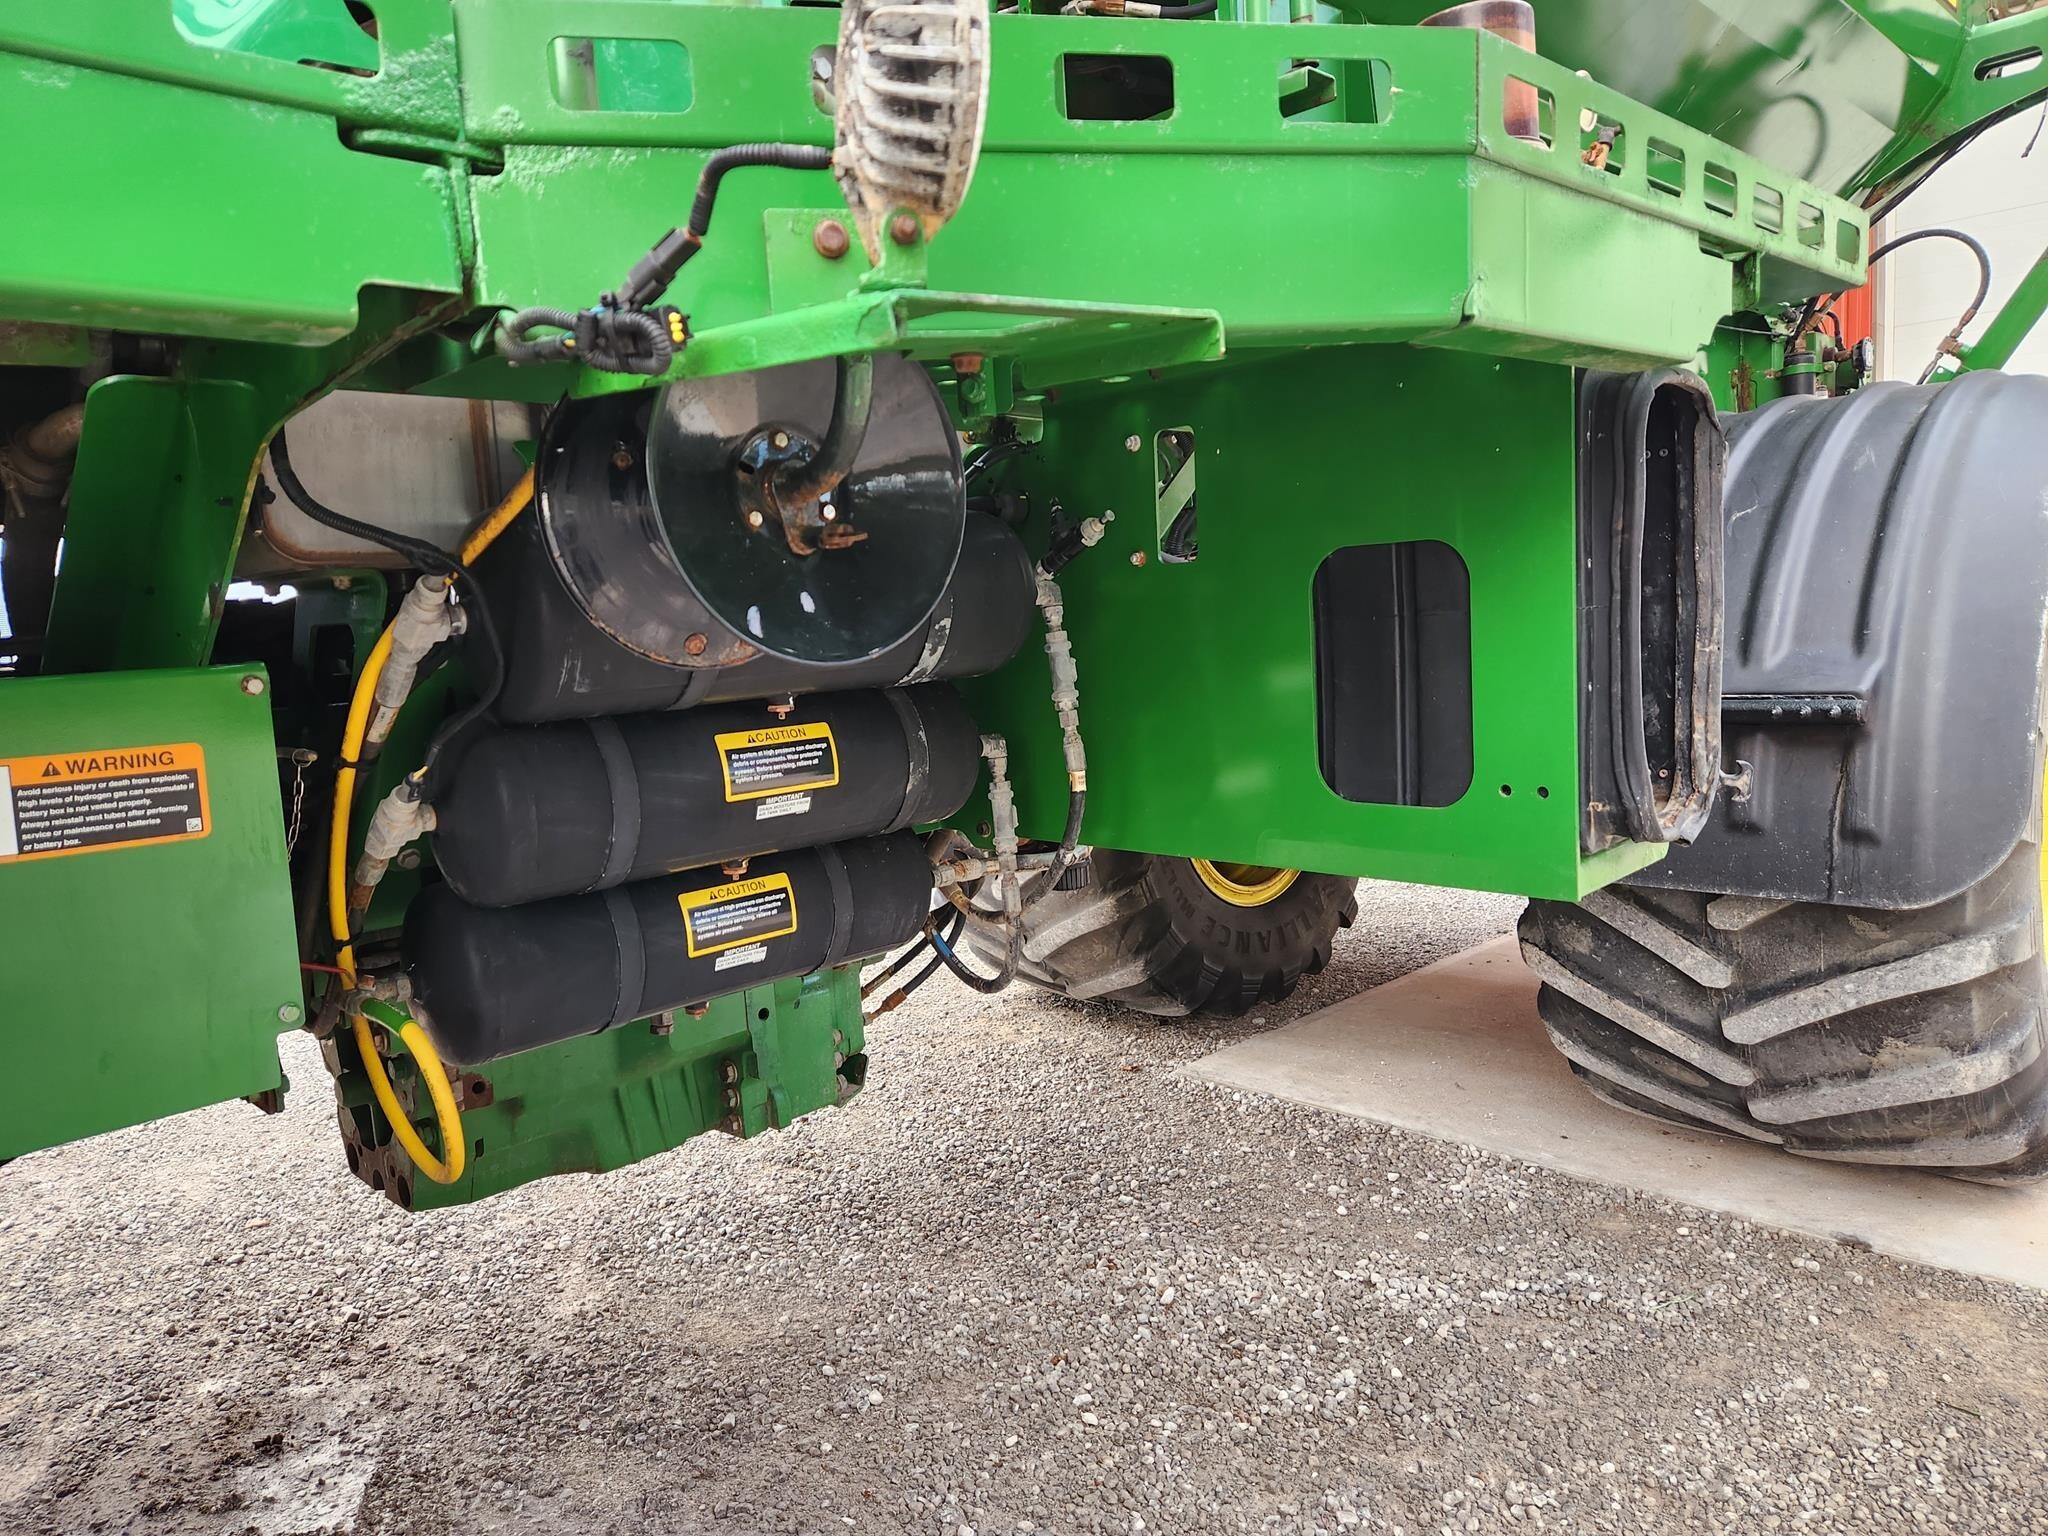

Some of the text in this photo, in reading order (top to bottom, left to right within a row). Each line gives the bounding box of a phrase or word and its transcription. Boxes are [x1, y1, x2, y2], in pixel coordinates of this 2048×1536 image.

[756, 728, 806, 741] CAUTION
[66, 751, 174, 774] WARNING
[761, 772, 783, 780] pressure.
[17, 788, 41, 796] Avoid
[42, 785, 72, 794] serious
[74, 783, 96, 791] injury
[108, 779, 130, 787] death
[151, 774, 190, 783] explosion.
[74, 792, 112, 802] hydrogen
[145, 783, 187, 794] accumulate
[91, 801, 117, 810] vented
[119, 798, 152, 808] properly.
[766, 793, 804, 804] IMPORTANT
[21, 821, 50, 829] Always
[52, 816, 84, 825] reinstall
[104, 811, 126, 819] tubes
[147, 804, 188, 815] performing
[22, 832, 51, 840] service
[64, 823, 114, 834] maintenance
[127, 818, 161, 827] batteries
[34, 840, 62, 849] battery
[718, 880, 766, 898] CAUTION
[735, 900, 755, 908] pressure
[765, 893, 786, 901] discharge
[759, 901, 781, 911] protective
[698, 932, 714, 941] system
[722, 925, 743, 935] pressure.
[724, 943, 760, 957] IMPORTANT
